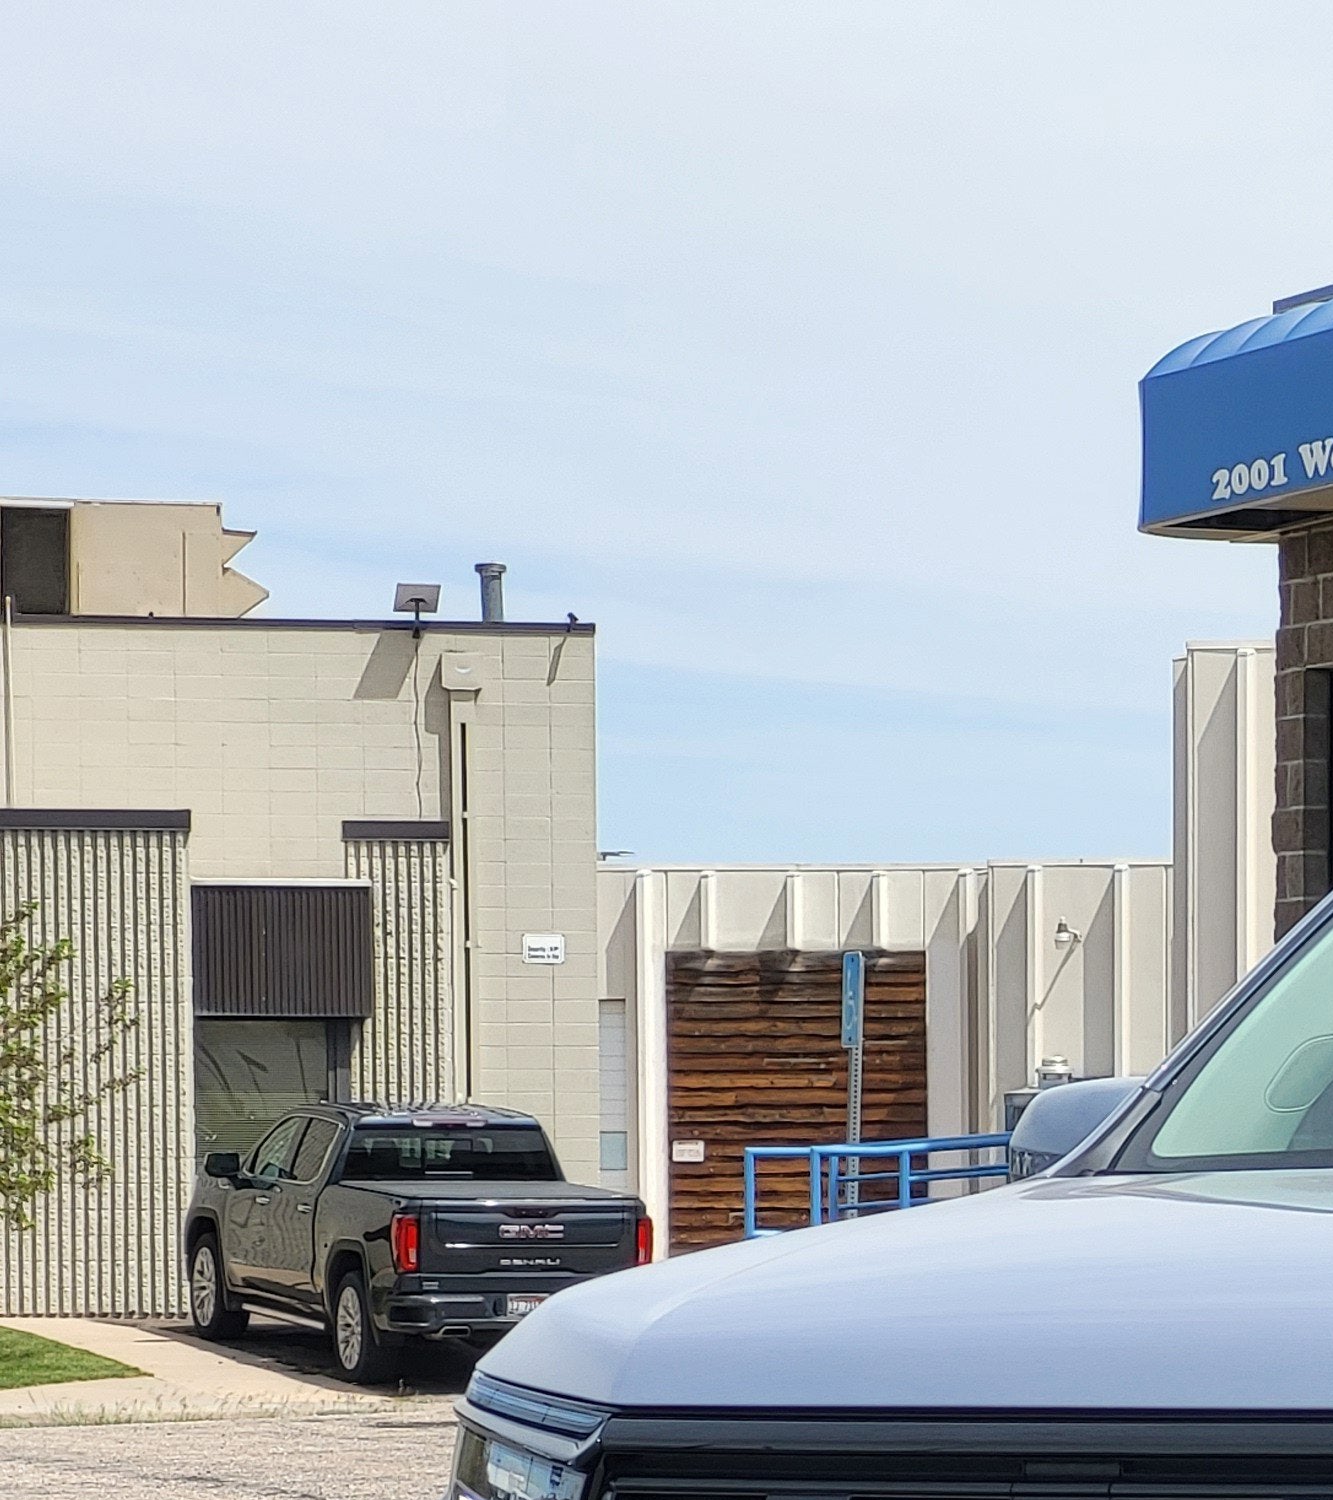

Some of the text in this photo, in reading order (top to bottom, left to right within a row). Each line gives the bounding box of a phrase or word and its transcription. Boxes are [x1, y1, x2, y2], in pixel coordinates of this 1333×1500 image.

[1211, 453, 1288, 501] 2001
[499, 1224, 565, 1239] GMC
[500, 1258, 561, 1266] DENALI
